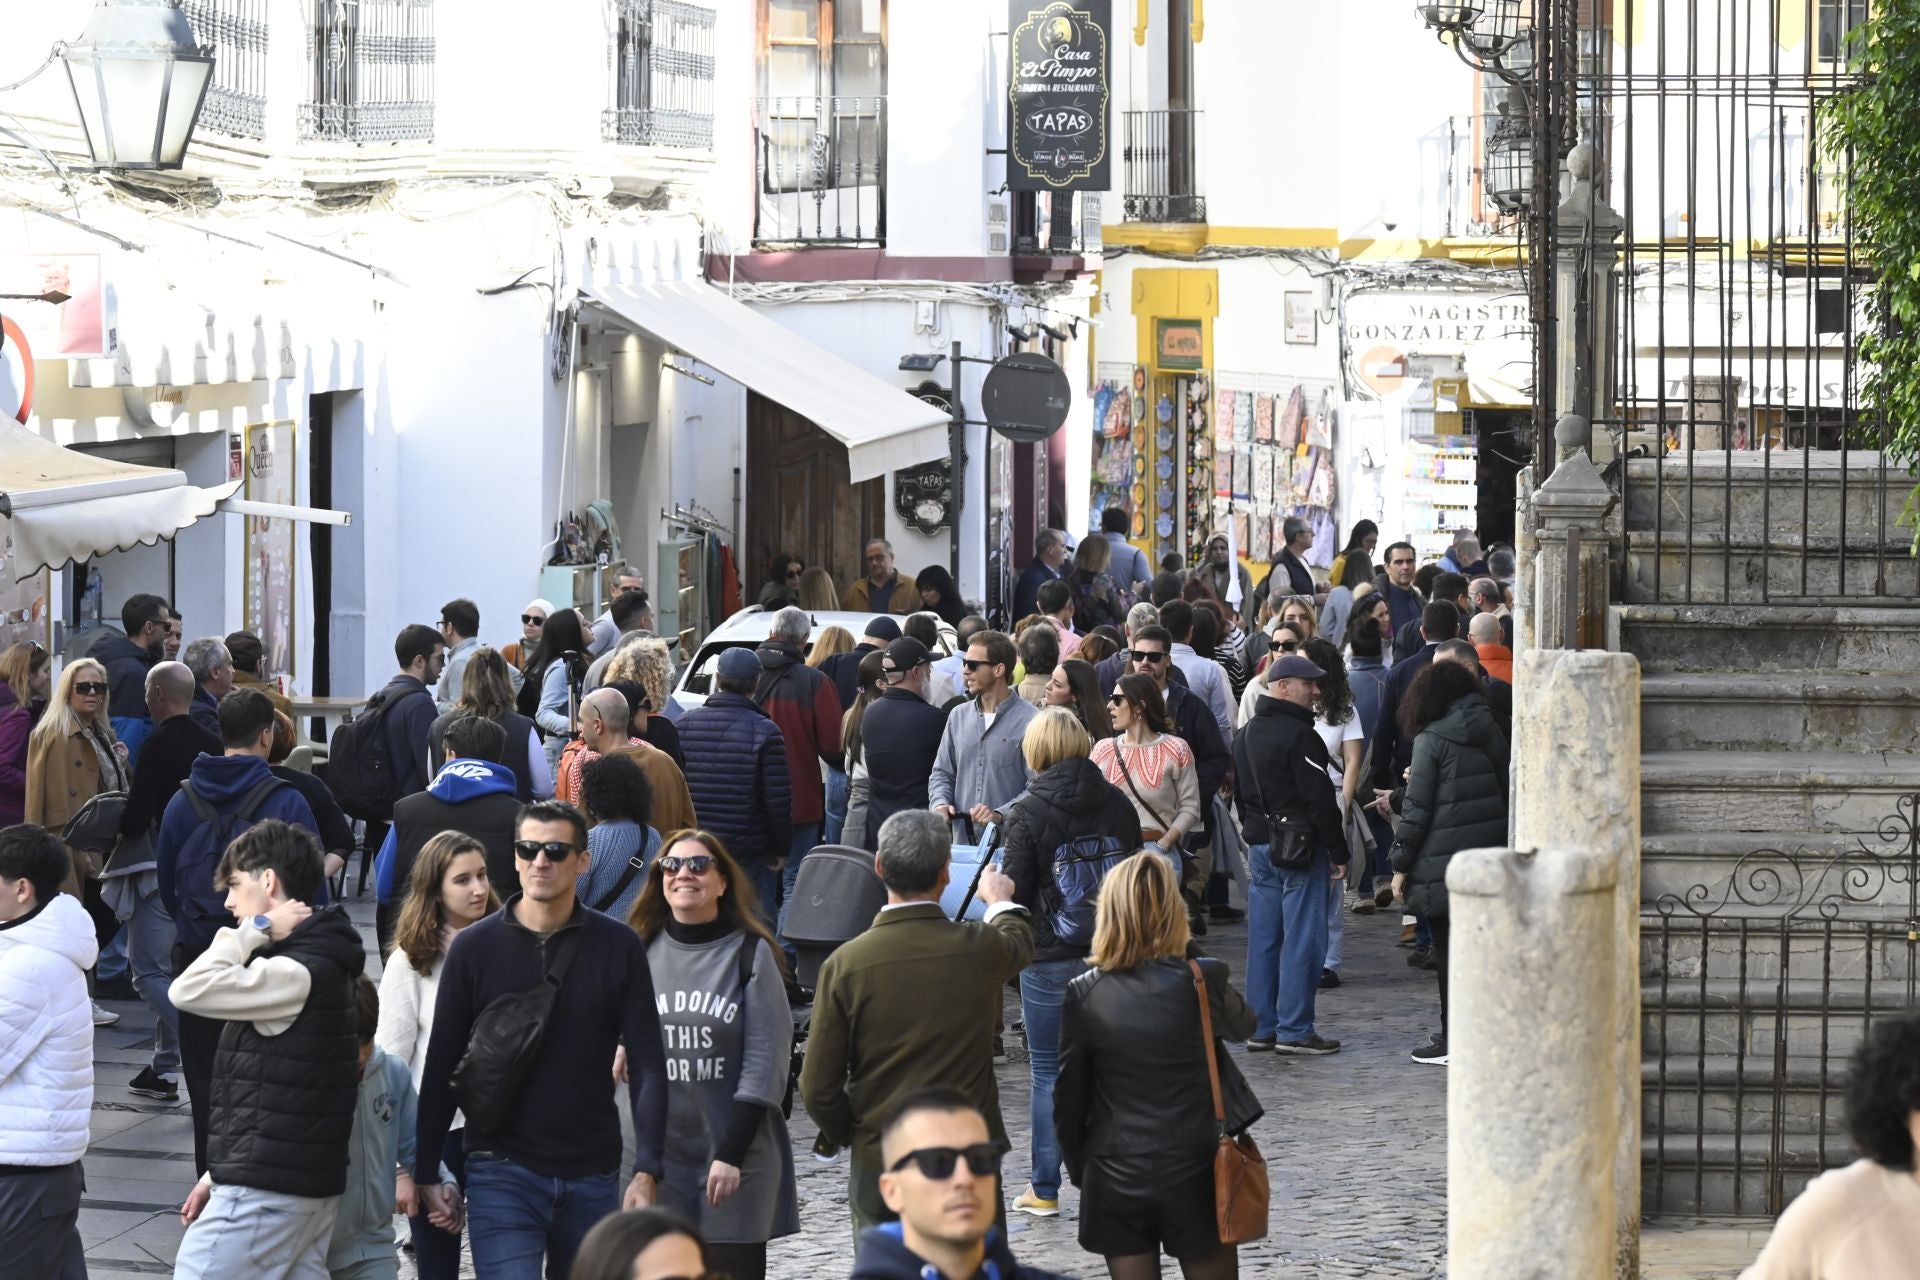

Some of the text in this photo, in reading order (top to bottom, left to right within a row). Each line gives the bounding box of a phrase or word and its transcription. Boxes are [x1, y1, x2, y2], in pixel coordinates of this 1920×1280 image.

[1054, 44, 1091, 61] Casa
[1020, 61, 1039, 77] El
[1053, 84, 1096, 92] RESTAURANTE
[1032, 112, 1086, 131] TAPAS
[1409, 304, 1524, 321] MAGISTR
[1504, 325, 1533, 341] FR
[250, 446, 273, 478] Queen
[918, 474, 942, 488] TAPAS
[675, 990, 738, 1024] DOING
[664, 1025, 713, 1049] THIS
[666, 1057, 725, 1082] OR ME
